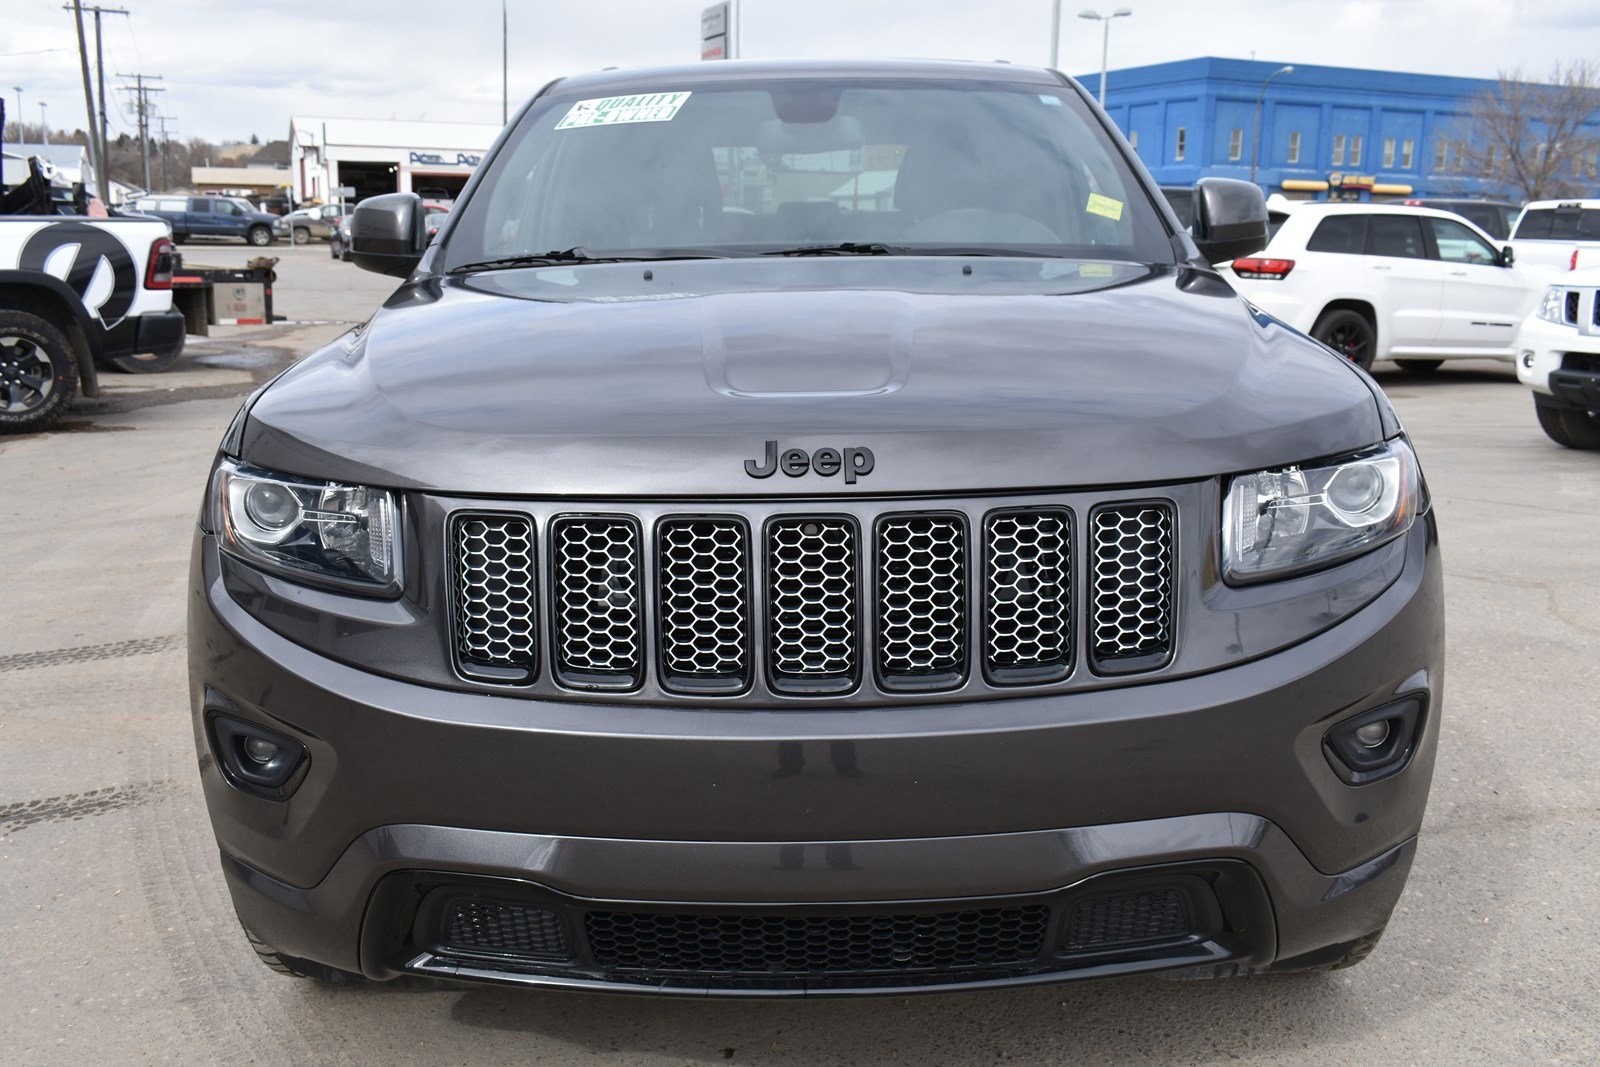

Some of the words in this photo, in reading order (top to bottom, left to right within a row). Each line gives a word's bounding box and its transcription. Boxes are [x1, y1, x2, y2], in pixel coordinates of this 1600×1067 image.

[594, 93, 684, 112] QUALITY
[560, 106, 677, 127] PRE-OWNED
[743, 440, 876, 485] Jeep
